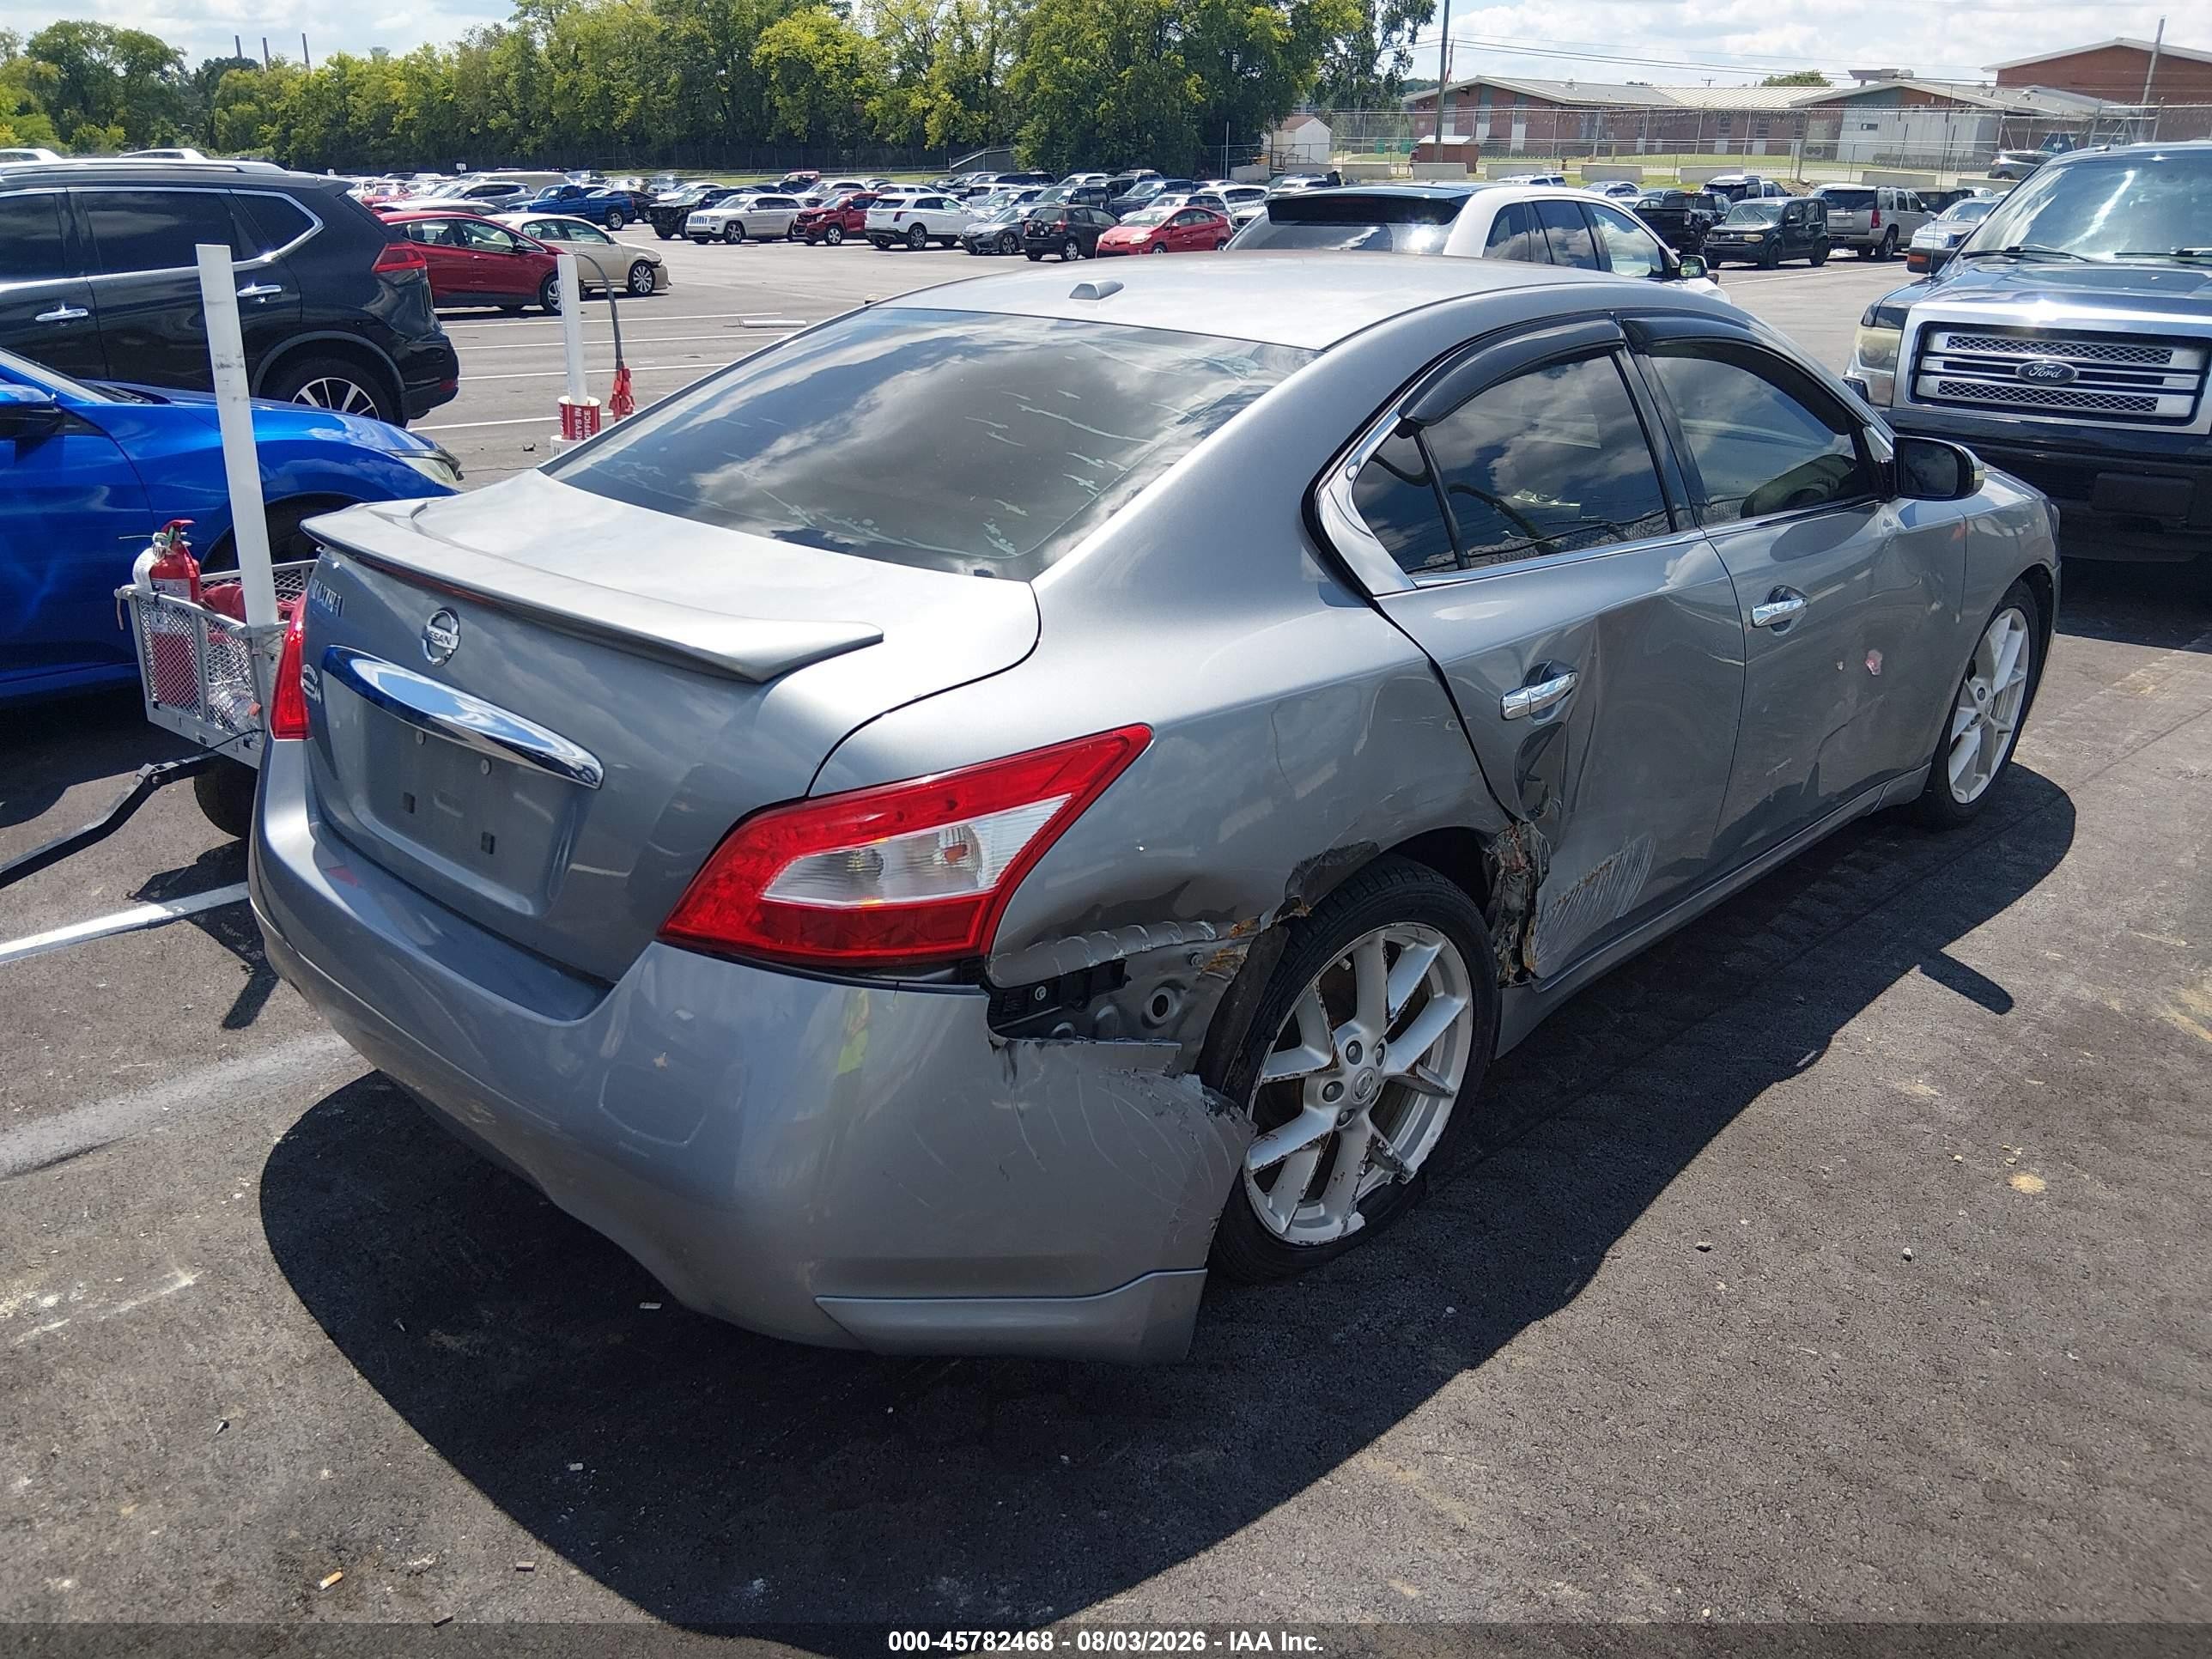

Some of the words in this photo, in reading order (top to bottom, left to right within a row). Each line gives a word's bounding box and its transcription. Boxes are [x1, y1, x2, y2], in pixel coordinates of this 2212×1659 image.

[2028, 363, 2063, 379] Ford
[574, 407, 582, 417] IN
[574, 419, 583, 441] KEYS
[426, 630, 453, 645] SSAN
